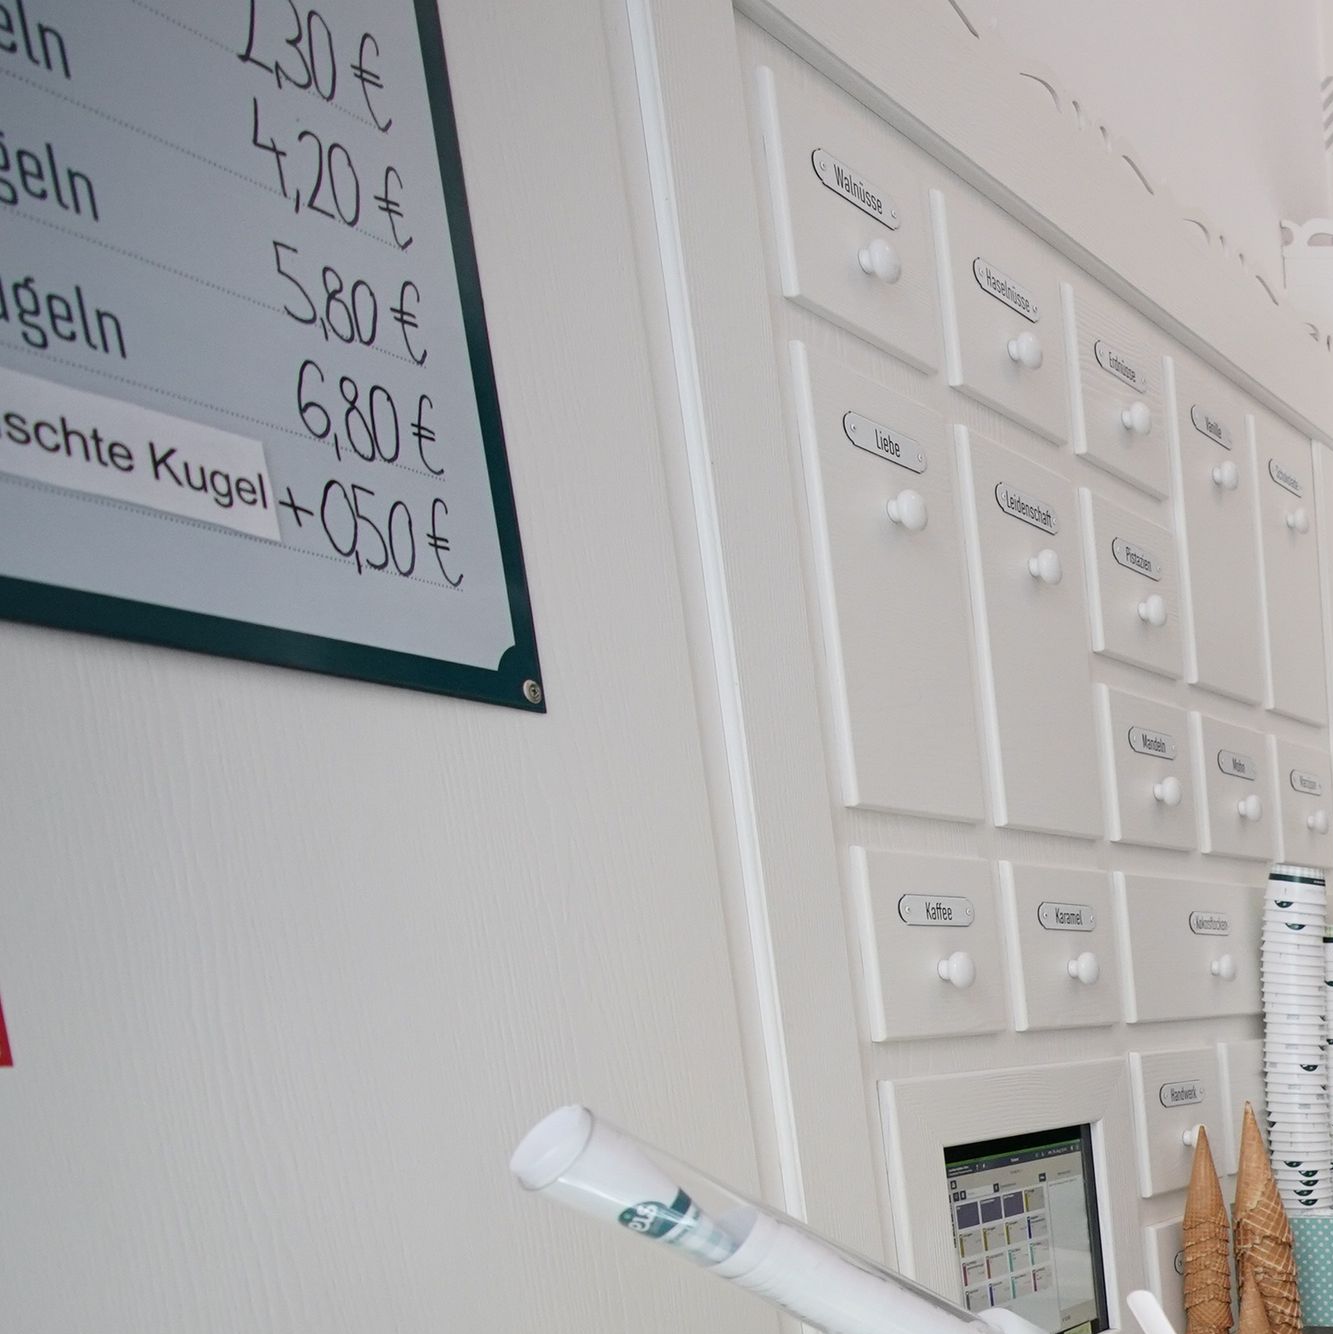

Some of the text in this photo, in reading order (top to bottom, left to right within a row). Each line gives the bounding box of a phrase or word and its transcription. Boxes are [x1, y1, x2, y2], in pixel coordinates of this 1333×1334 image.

[351, 32, 392, 134] €
[253, 97, 360, 227] 4,20
[374, 166, 413, 250] €
[833, 163, 883, 215] Walnüsse
[273, 241, 378, 346] 5,80
[391, 281, 428, 365] €
[986, 267, 1030, 313] Haselnüsse
[0, 276, 445, 475] geln 6,80 €
[874, 428, 901, 458] Liebe
[149, 441, 267, 509] Kugel
[427, 498, 464, 587] €
[1006, 490, 1052, 529] Leidenschaft
[1125, 546, 1152, 573] Pistazien
[1142, 734, 1167, 754] Mandeln
[925, 902, 953, 921] Kaffee
[1054, 907, 1084, 926] Karamel
